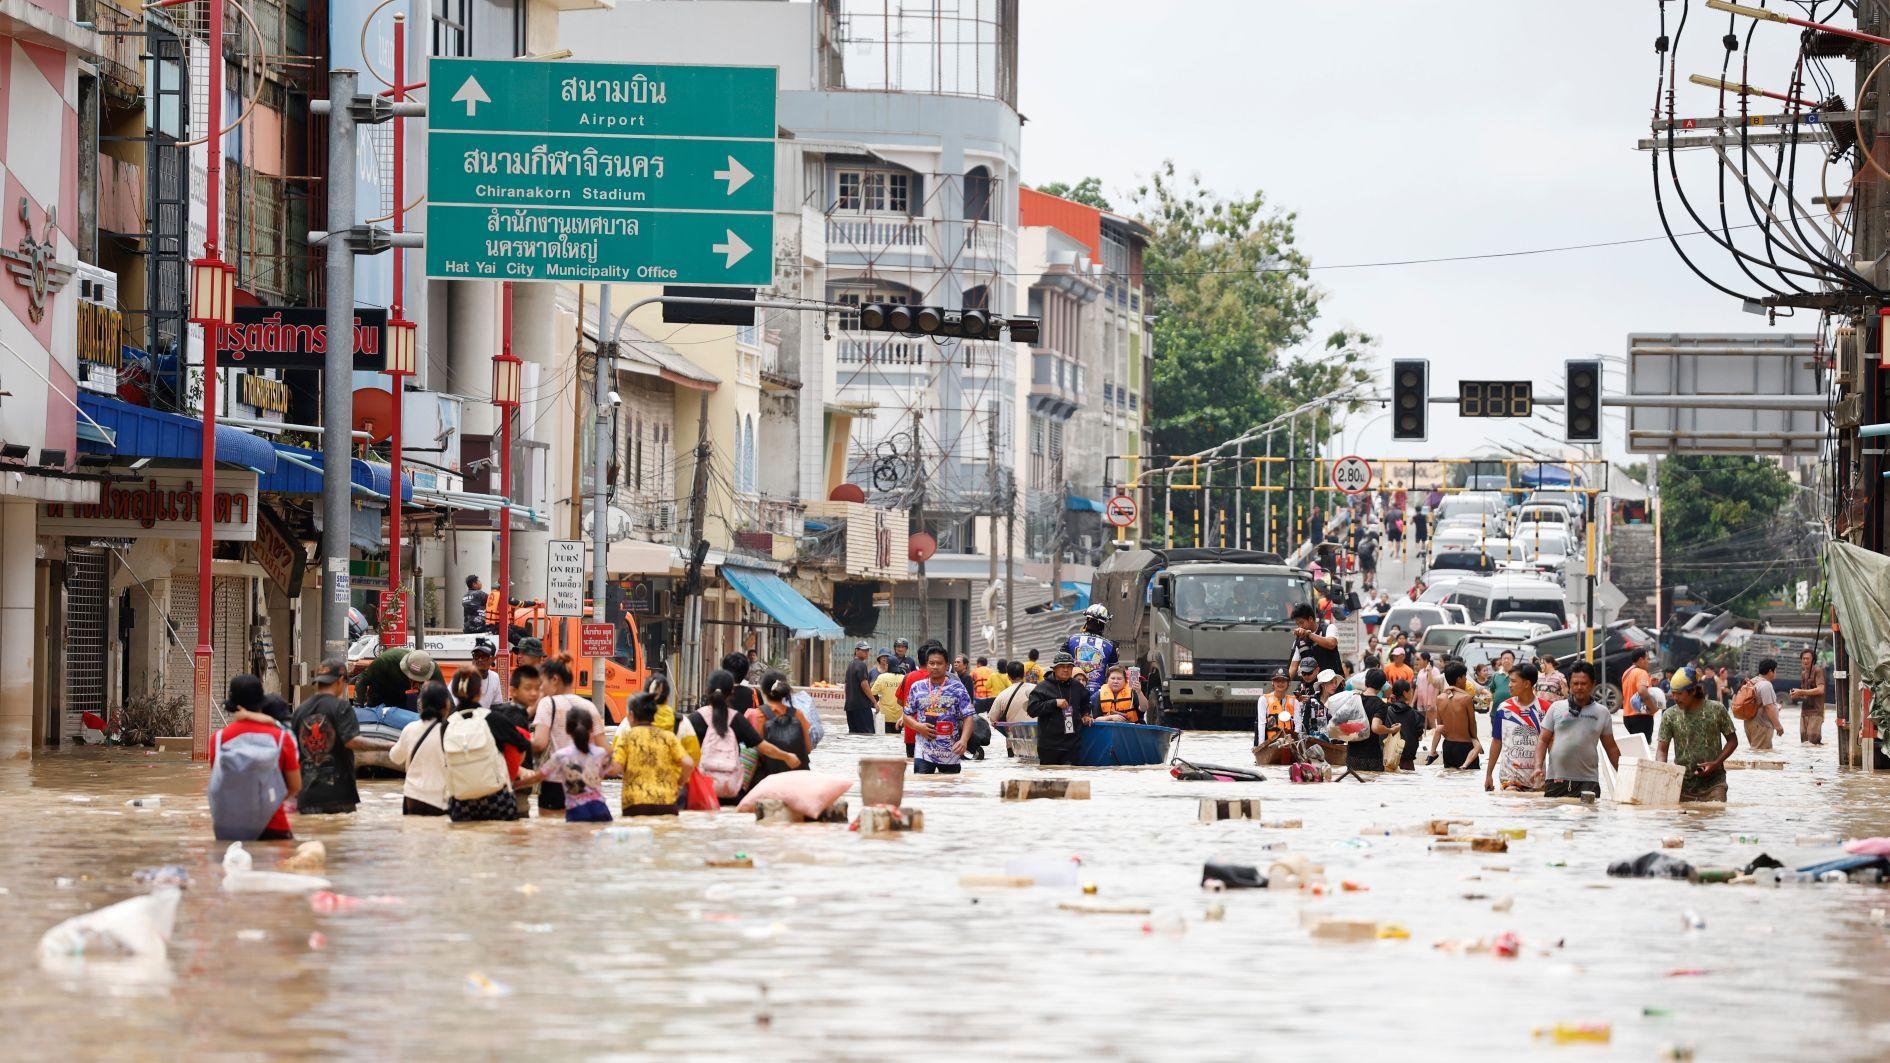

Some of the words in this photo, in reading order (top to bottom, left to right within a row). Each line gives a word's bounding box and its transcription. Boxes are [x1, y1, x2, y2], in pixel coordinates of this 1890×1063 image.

[561, 74, 667, 104] สนามบิน
[579, 114, 645, 127] Airport
[463, 144, 664, 178] สนามกีฬาจิรนคร
[475, 185, 571, 198] Chiranakorn
[582, 187, 646, 201] Stadium
[487, 208, 639, 236] สำนักงานเทศบาล
[485, 228, 598, 263] นครหาดใหญ่
[445, 261, 470, 273] Hat
[475, 262, 497, 274] Yai
[506, 262, 534, 278] City
[546, 263, 630, 279] Municipality
[637, 266, 678, 279] Office
[555, 553, 579, 562] TURN
[424, 642, 444, 650] PRO
